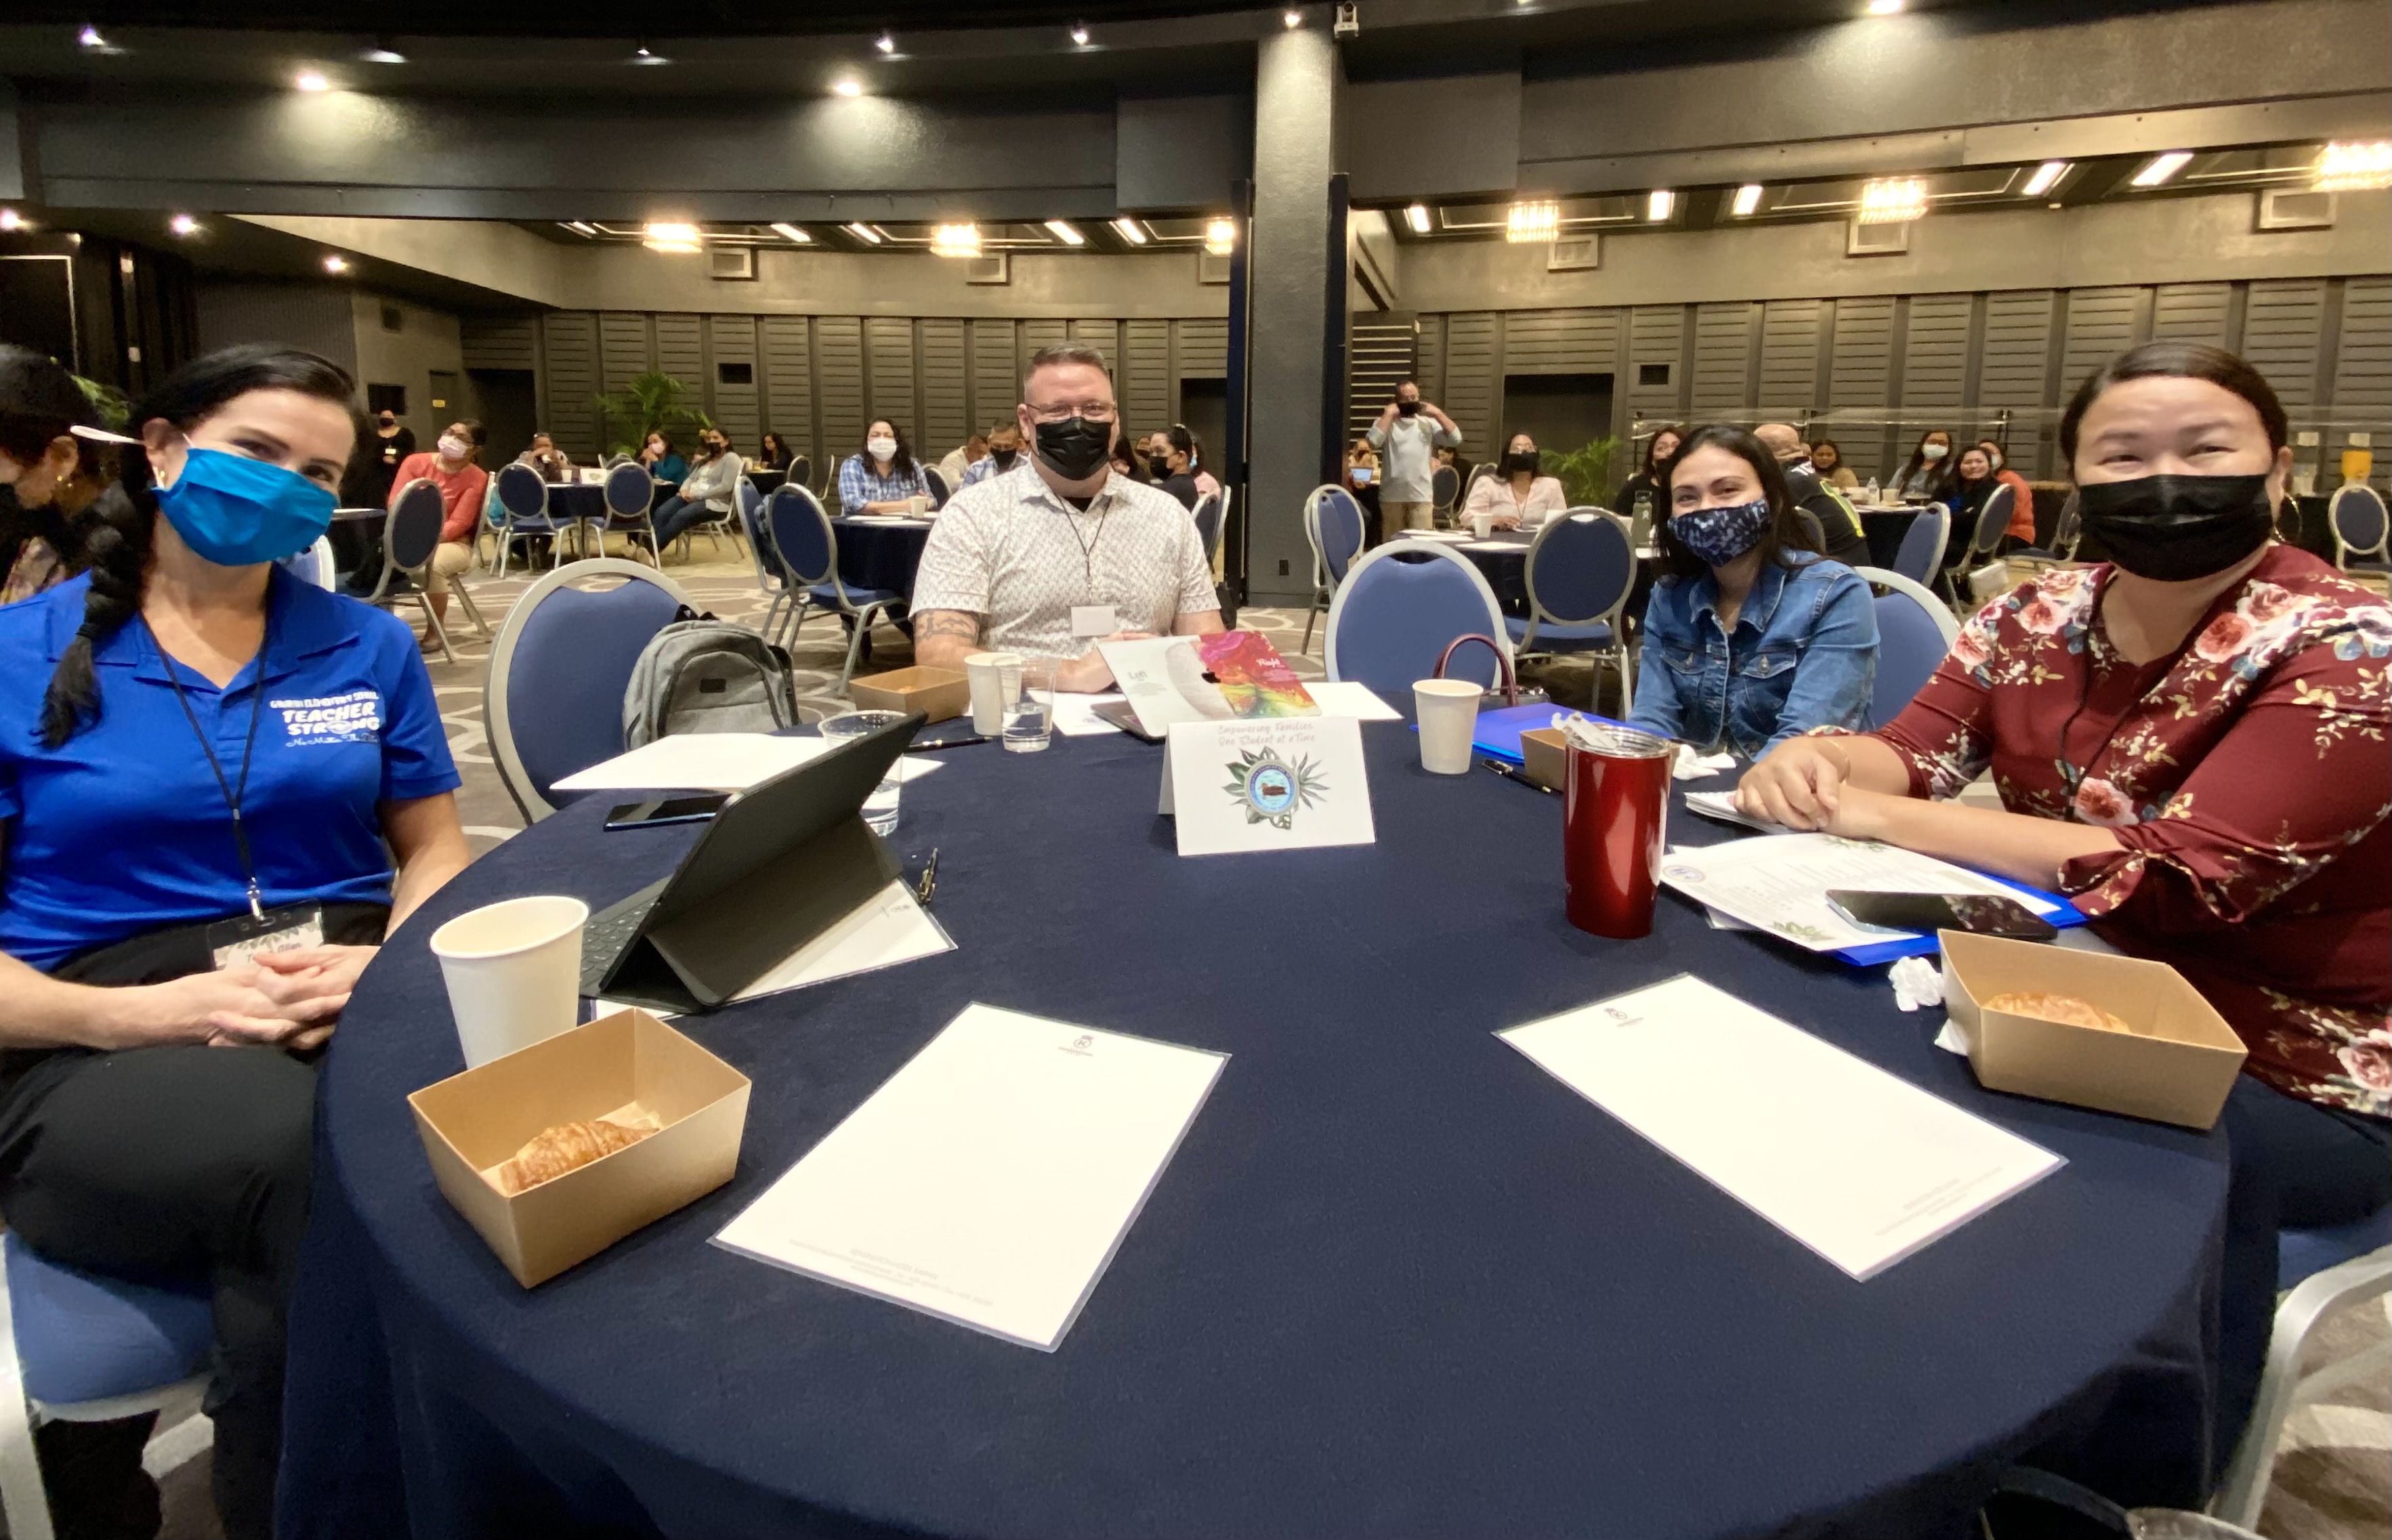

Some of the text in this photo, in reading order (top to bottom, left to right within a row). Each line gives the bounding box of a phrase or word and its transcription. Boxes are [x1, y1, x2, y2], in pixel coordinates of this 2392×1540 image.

[1128, 670, 1148, 680] Left
[282, 702, 376, 723] TEACHER
[1218, 721, 1314, 735] Empowering Families
[1218, 736, 1235, 746] One
[1240, 735, 1273, 745] Student
[1277, 734, 1285, 744] at
[1293, 733, 1316, 743] Time
